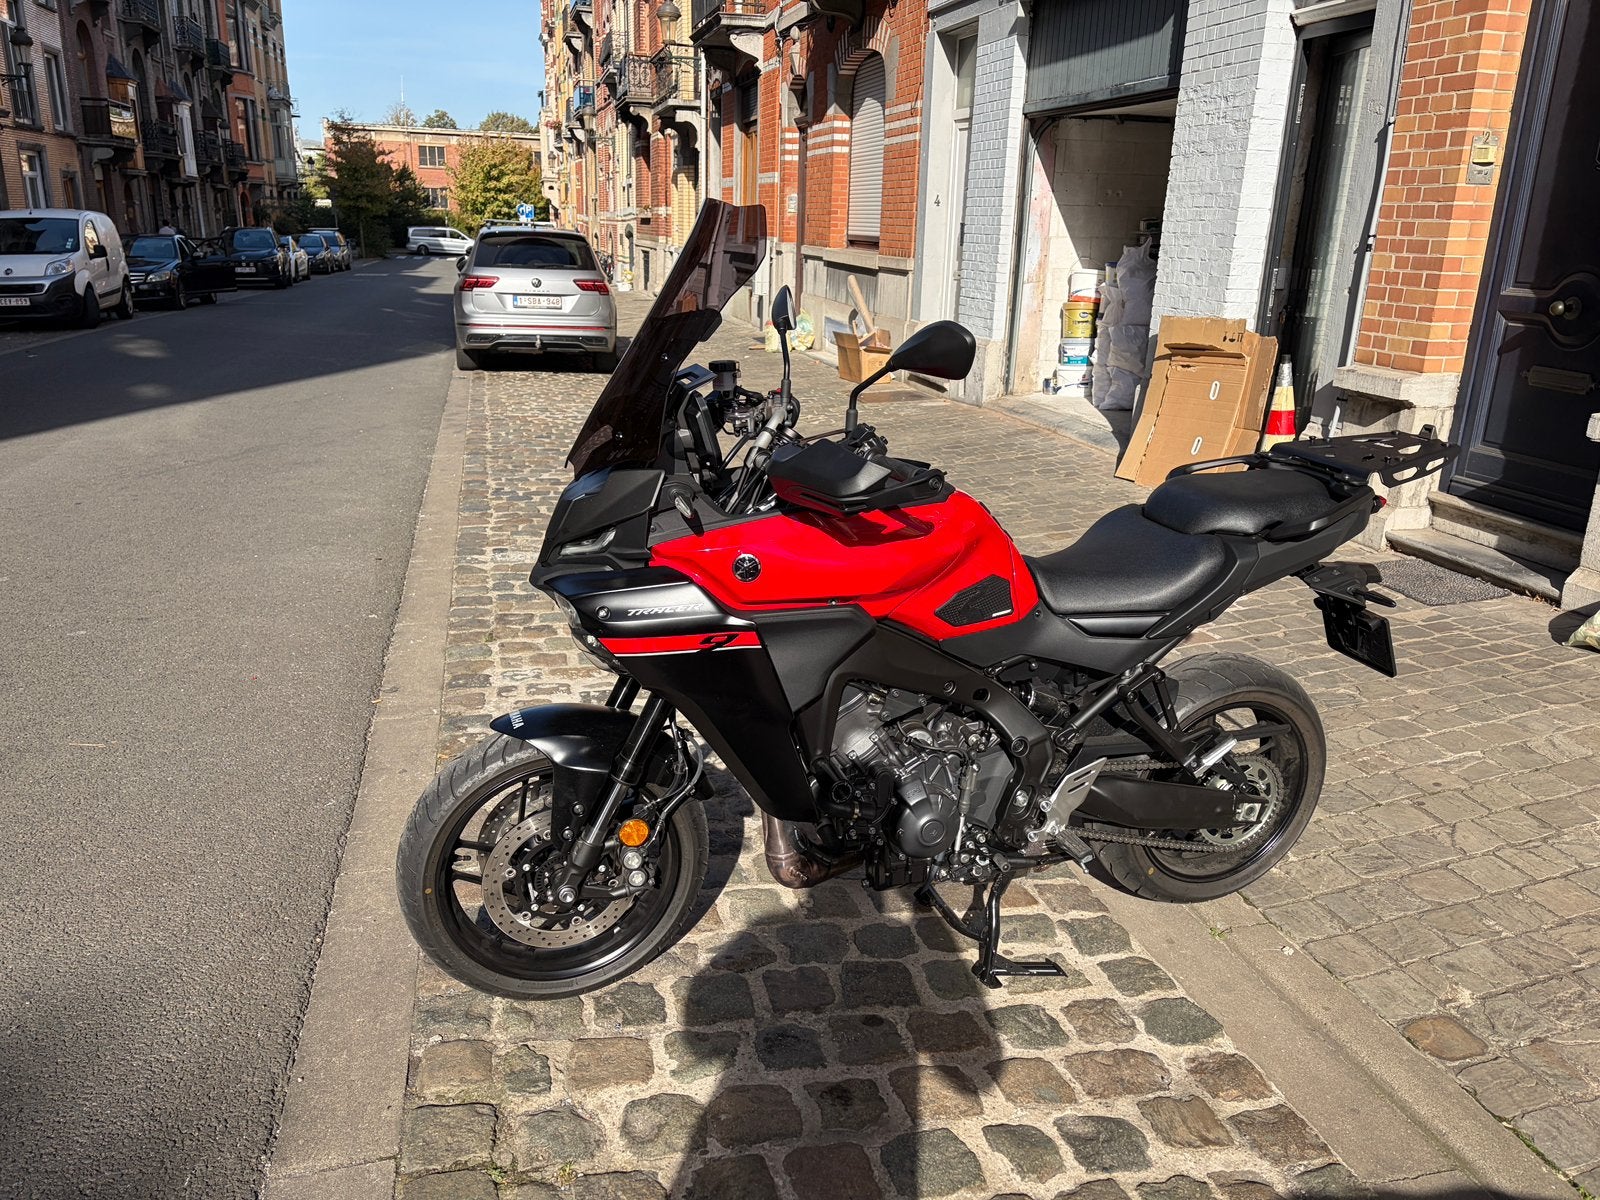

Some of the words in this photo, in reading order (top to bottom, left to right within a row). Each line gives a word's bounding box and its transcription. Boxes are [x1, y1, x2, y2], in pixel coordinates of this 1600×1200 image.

[934, 194, 941, 207] 4
[627, 602, 704, 617] TRACER
[700, 633, 740, 653] 9
